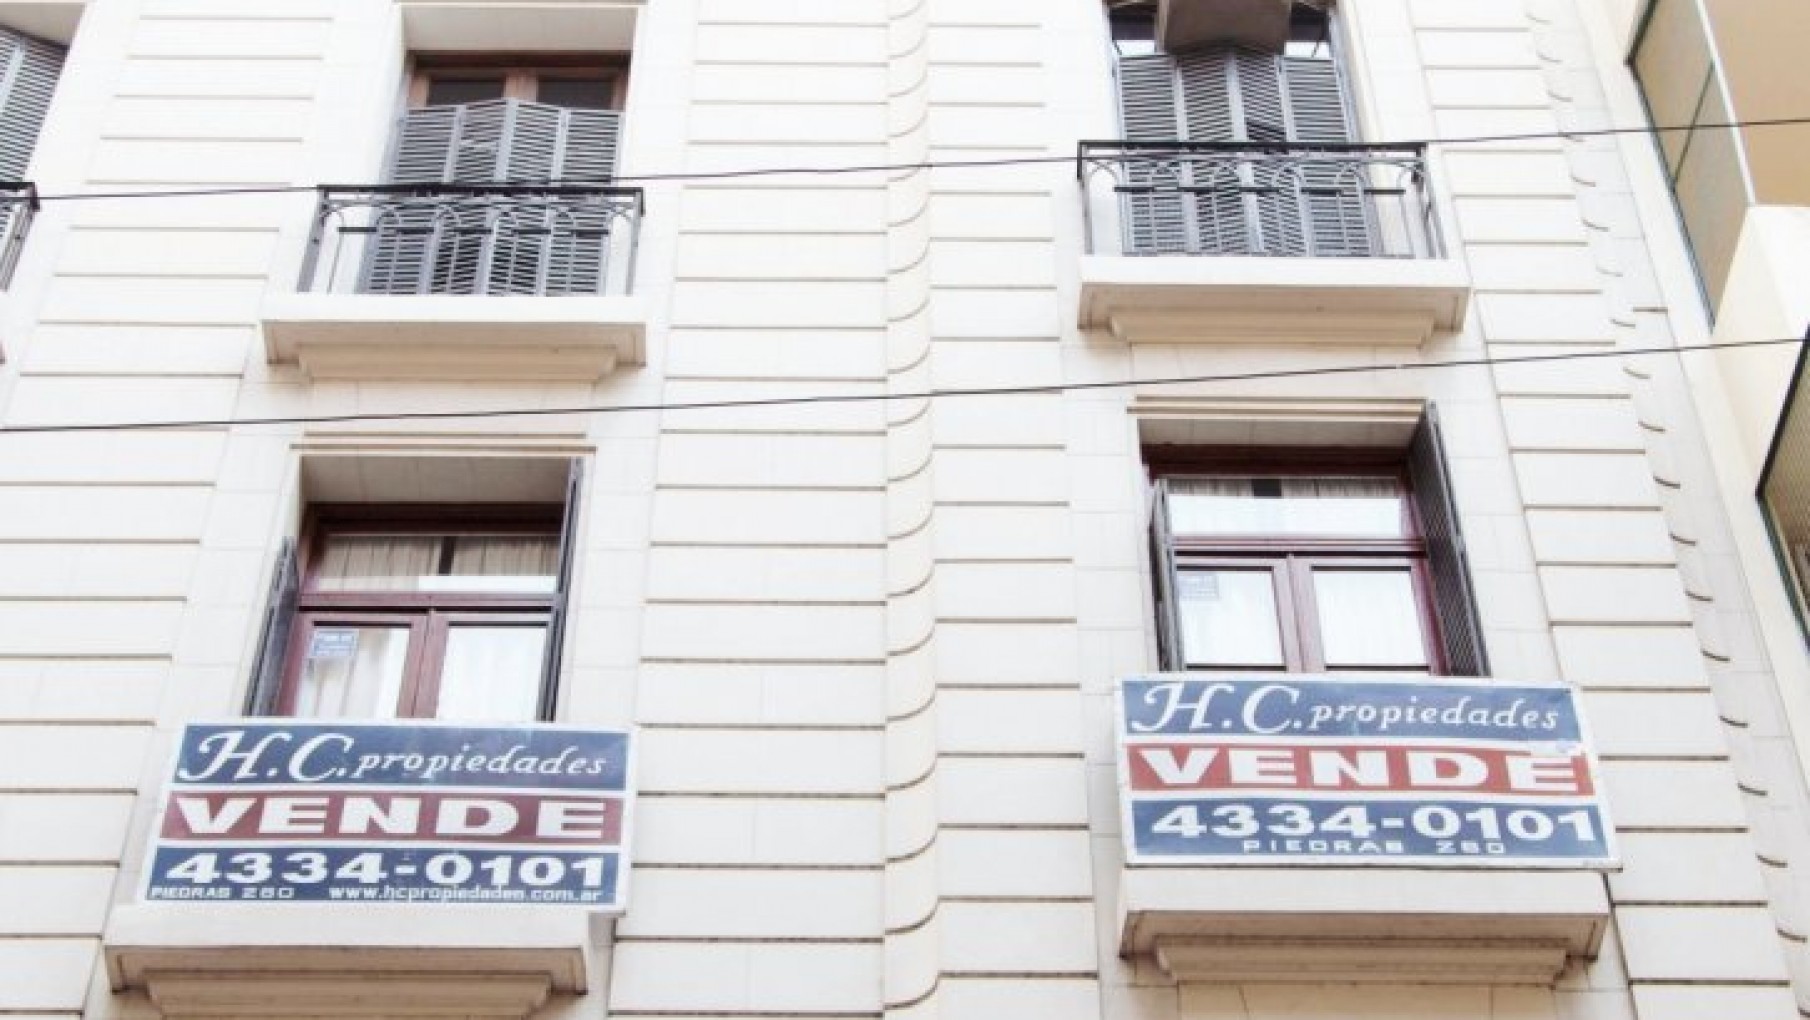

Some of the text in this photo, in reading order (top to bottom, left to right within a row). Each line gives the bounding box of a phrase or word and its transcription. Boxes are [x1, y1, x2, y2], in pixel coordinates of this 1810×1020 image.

[1130, 684, 1560, 735] H.C. propiedades
[177, 730, 605, 782] H.C. propiedades
[1139, 748, 1579, 792] VENDE
[175, 797, 605, 840] VENDE
[1150, 803, 1597, 842] 4334-0101
[166, 851, 605, 888] 4334-0101
